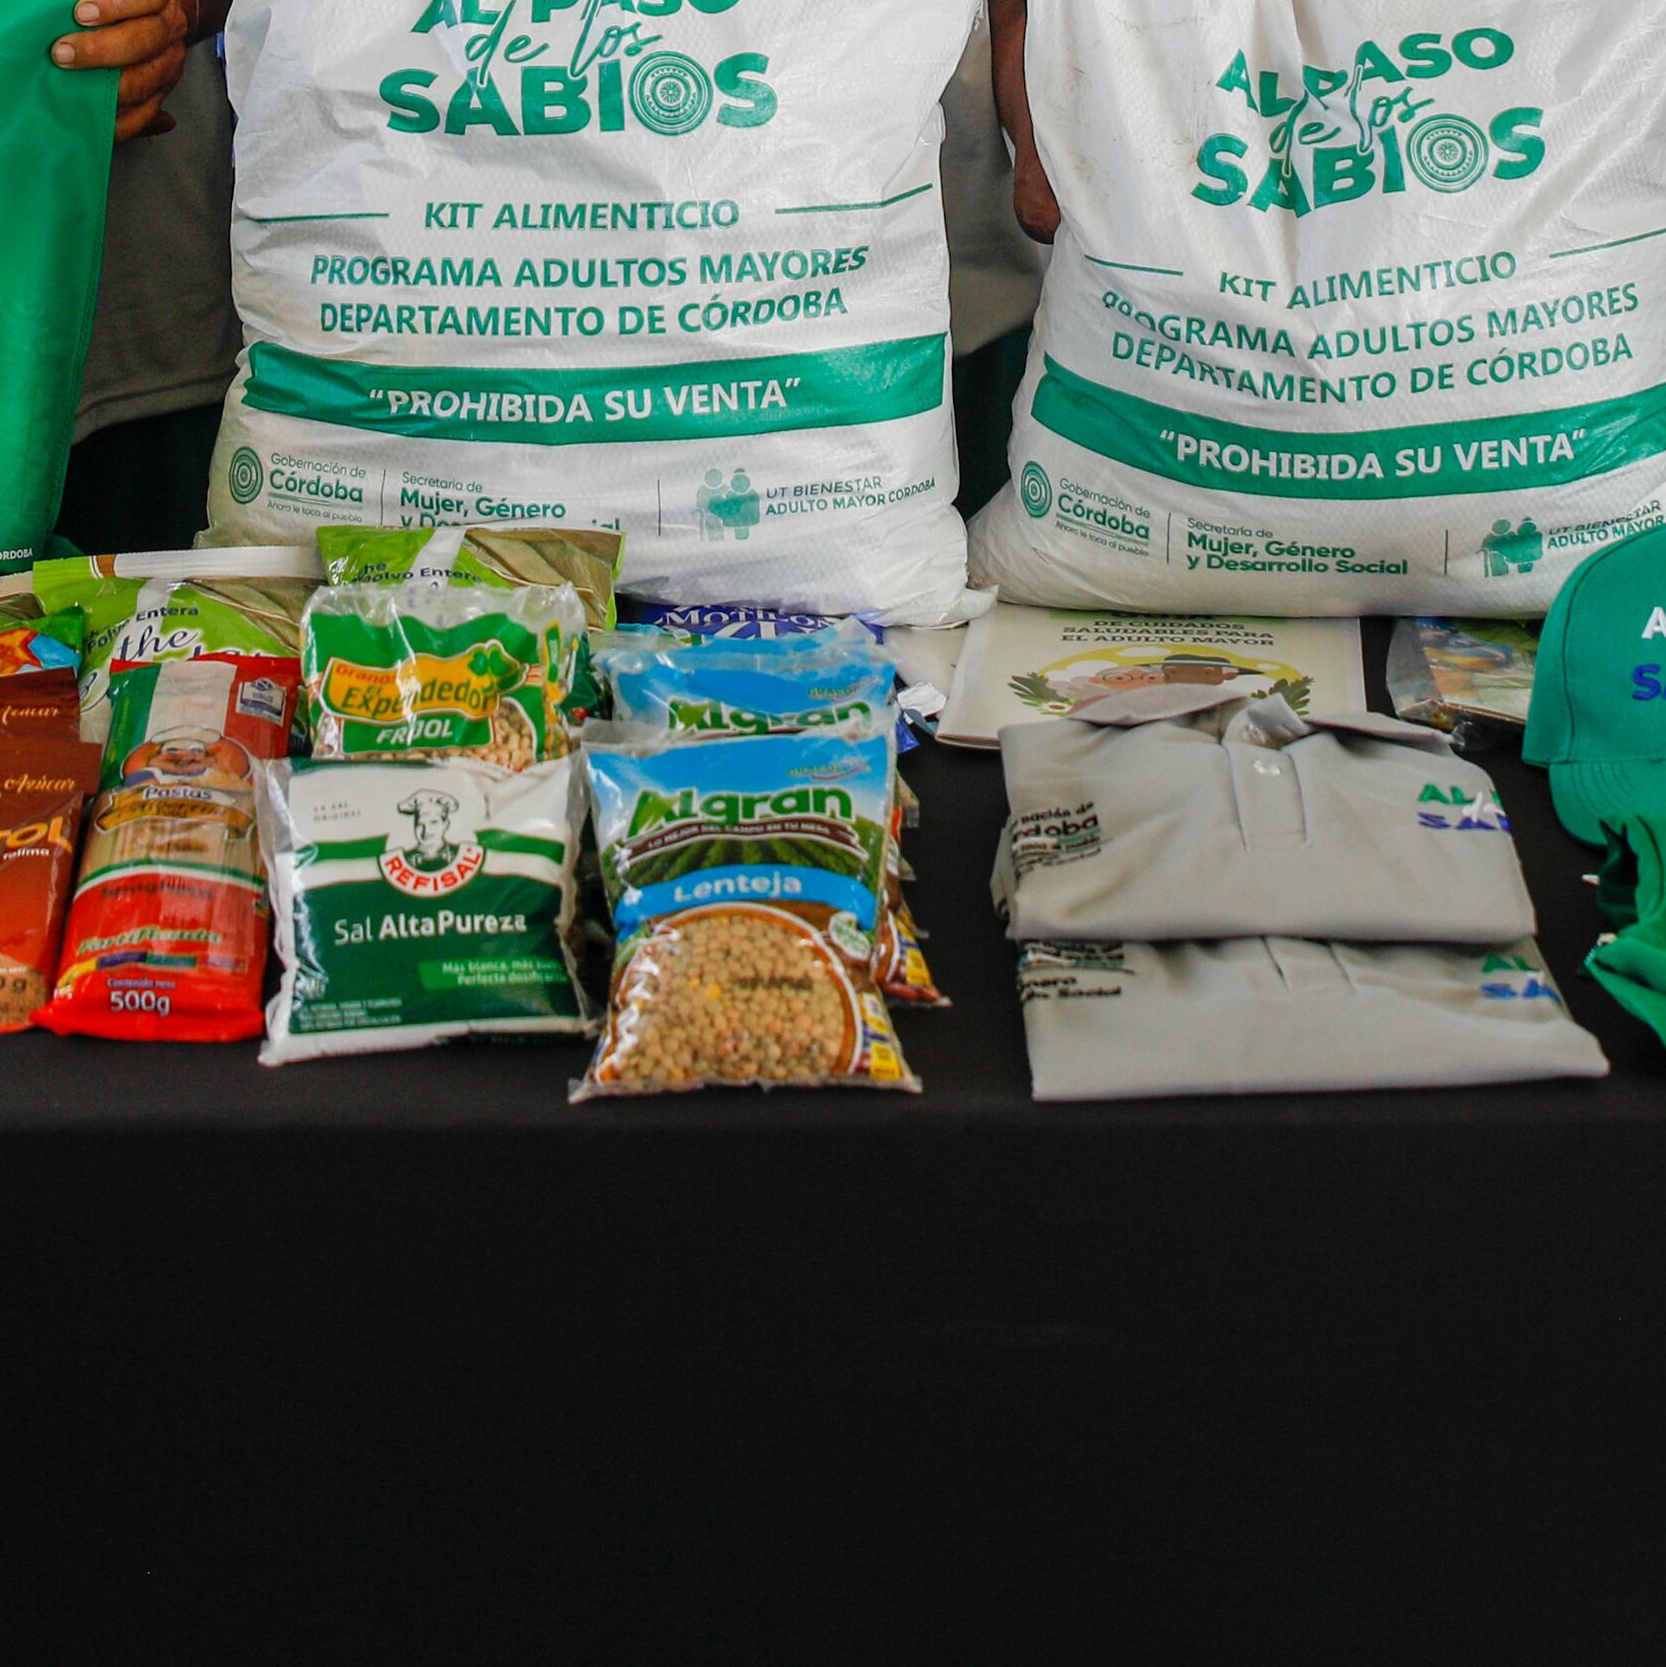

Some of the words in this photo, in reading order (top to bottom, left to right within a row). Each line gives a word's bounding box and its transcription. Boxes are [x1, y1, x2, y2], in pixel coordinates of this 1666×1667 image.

[465, 0, 550, 87] de
[379, 50, 778, 137] SABIOS
[1215, 49, 1301, 118] AL
[1189, 105, 1546, 218] SABIOS
[425, 202, 482, 229] KIT
[495, 200, 740, 230] ALIMENTICIO
[310, 254, 502, 288] PROGRAMA
[514, 255, 687, 288] ADULTOS
[699, 245, 869, 284] MAYORES
[1219, 270, 1276, 302] KIT
[1287, 250, 1516, 309] ALIMENTICIO
[320, 301, 611, 337] DEPARTAMENTO
[620, 305, 667, 334] DE
[677, 288, 849, 332] CÓRDOBA
[1487, 282, 1639, 337] MAYORES
[1112, 330, 1397, 404] DEPARTAMENTO
[1409, 366, 1455, 393] DE
[1466, 333, 1633, 384] CÓRDOBA
[604, 389, 652, 420] SU
[271, 453, 347, 477] Gobernación
[350, 467, 365, 479] de
[1395, 443, 1443, 474] SU
[269, 468, 363, 502] Córdoba
[468, 482, 482, 493] de
[767, 487, 787, 499] UT
[793, 476, 882, 497] BIENESTAR
[1059, 477, 1133, 513] Gobernación
[1135, 503, 1151, 518] de
[400, 488, 469, 519] Mujer,
[475, 495, 565, 519] Género
[766, 498, 828, 515] ADULTO
[833, 493, 884, 510] MAYOR
[1057, 494, 1150, 540] Córdoba
[1187, 532, 1258, 558] Mujer,
[1265, 537, 1355, 559] Género
[1256, 528, 1273, 538] de
[1547, 529, 1608, 549] ADULTO
[1188, 552, 1200, 569] y
[1207, 553, 1329, 573] Desarrollo
[1336, 556, 1408, 575] Social
[136, 605, 199, 622] Entera
[1095, 635, 1185, 643] ADULTO
[1192, 637, 1275, 646] MAYOR
[1215, 630, 1274, 639] PARA
[144, 786, 212, 801] Pastas
[385, 847, 481, 892] REFISAL
[675, 871, 802, 902] Lenteja
[334, 915, 373, 946] Sal
[110, 990, 170, 1016] 500g
